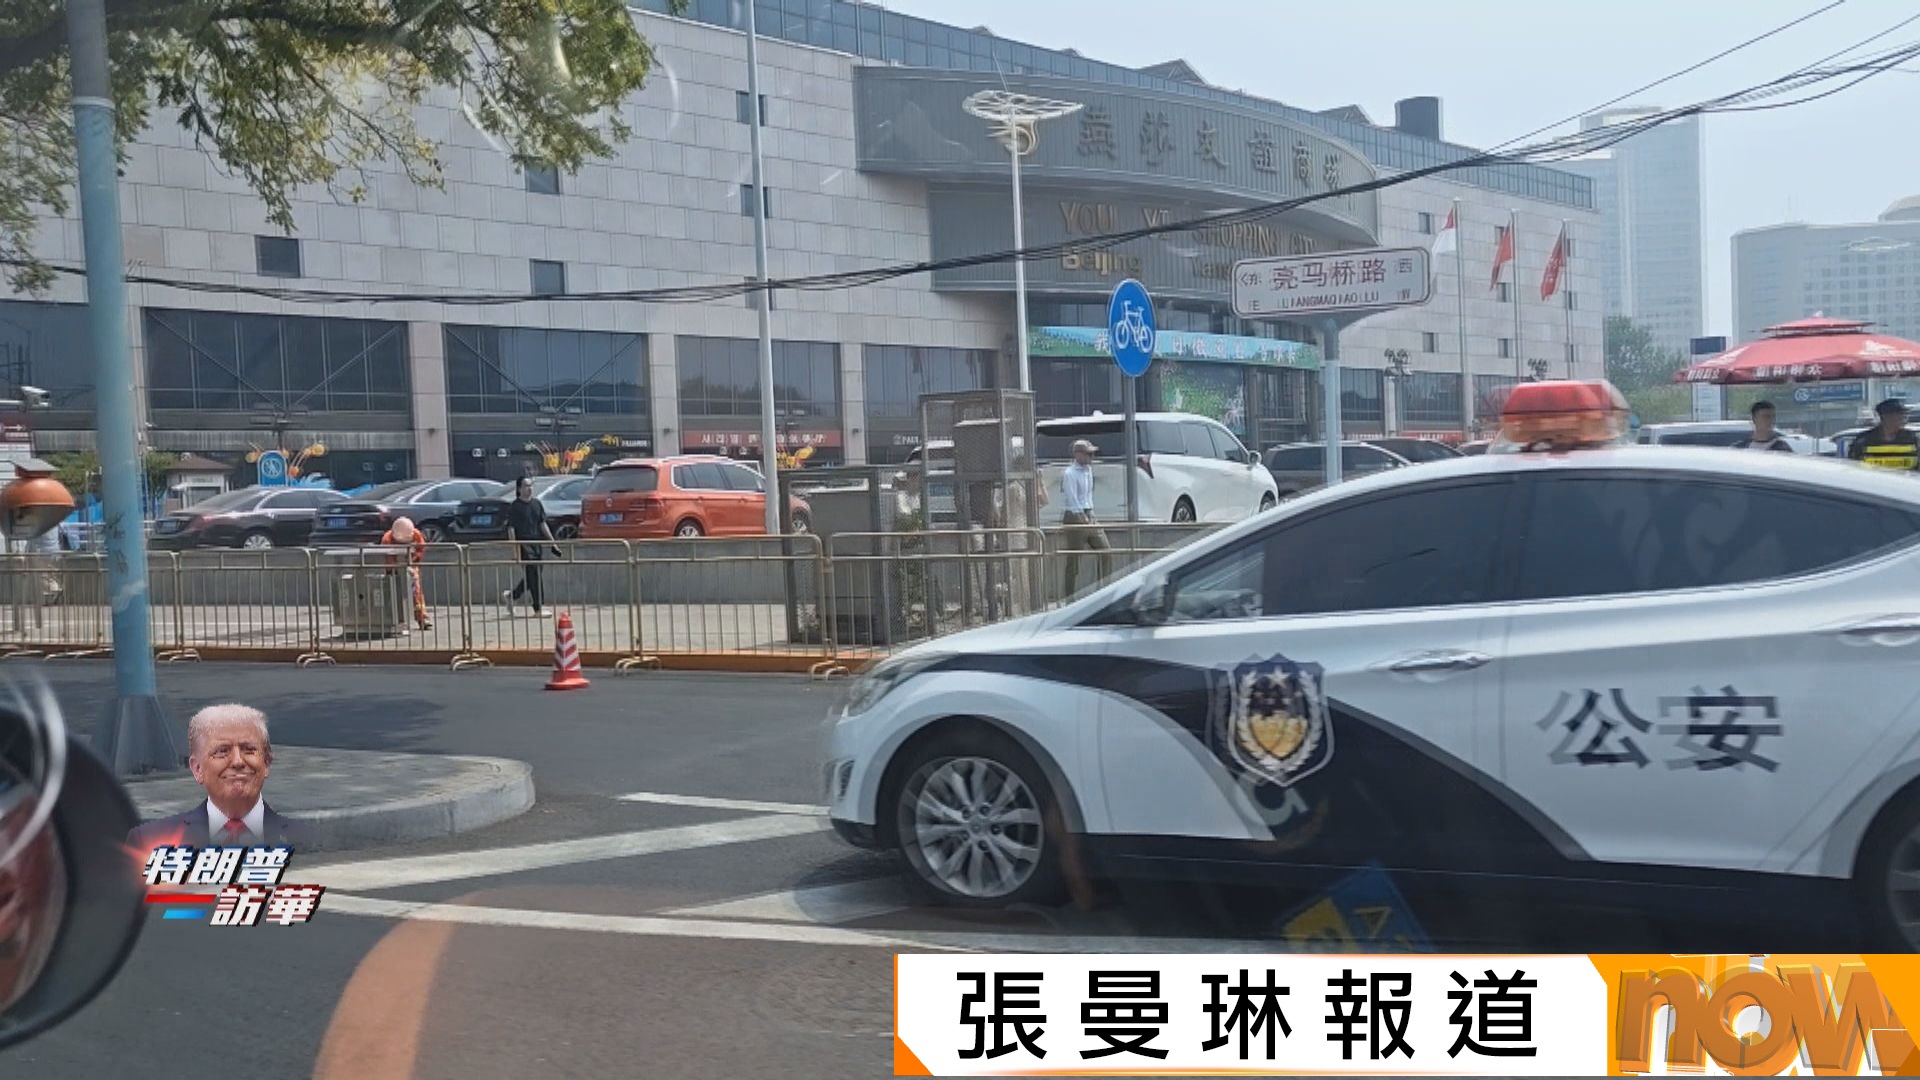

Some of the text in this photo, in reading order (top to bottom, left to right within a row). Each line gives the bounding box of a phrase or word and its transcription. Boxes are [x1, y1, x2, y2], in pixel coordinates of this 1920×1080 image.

[1060, 201, 1117, 235] YOU
[1062, 246, 1141, 278] Beijing
[1272, 258, 1386, 291] 亮马桥路
[1398, 257, 1413, 274] 西
[1250, 287, 1411, 312] E LIANGMAQIAO LU W
[1535, 685, 1784, 773] 公安
